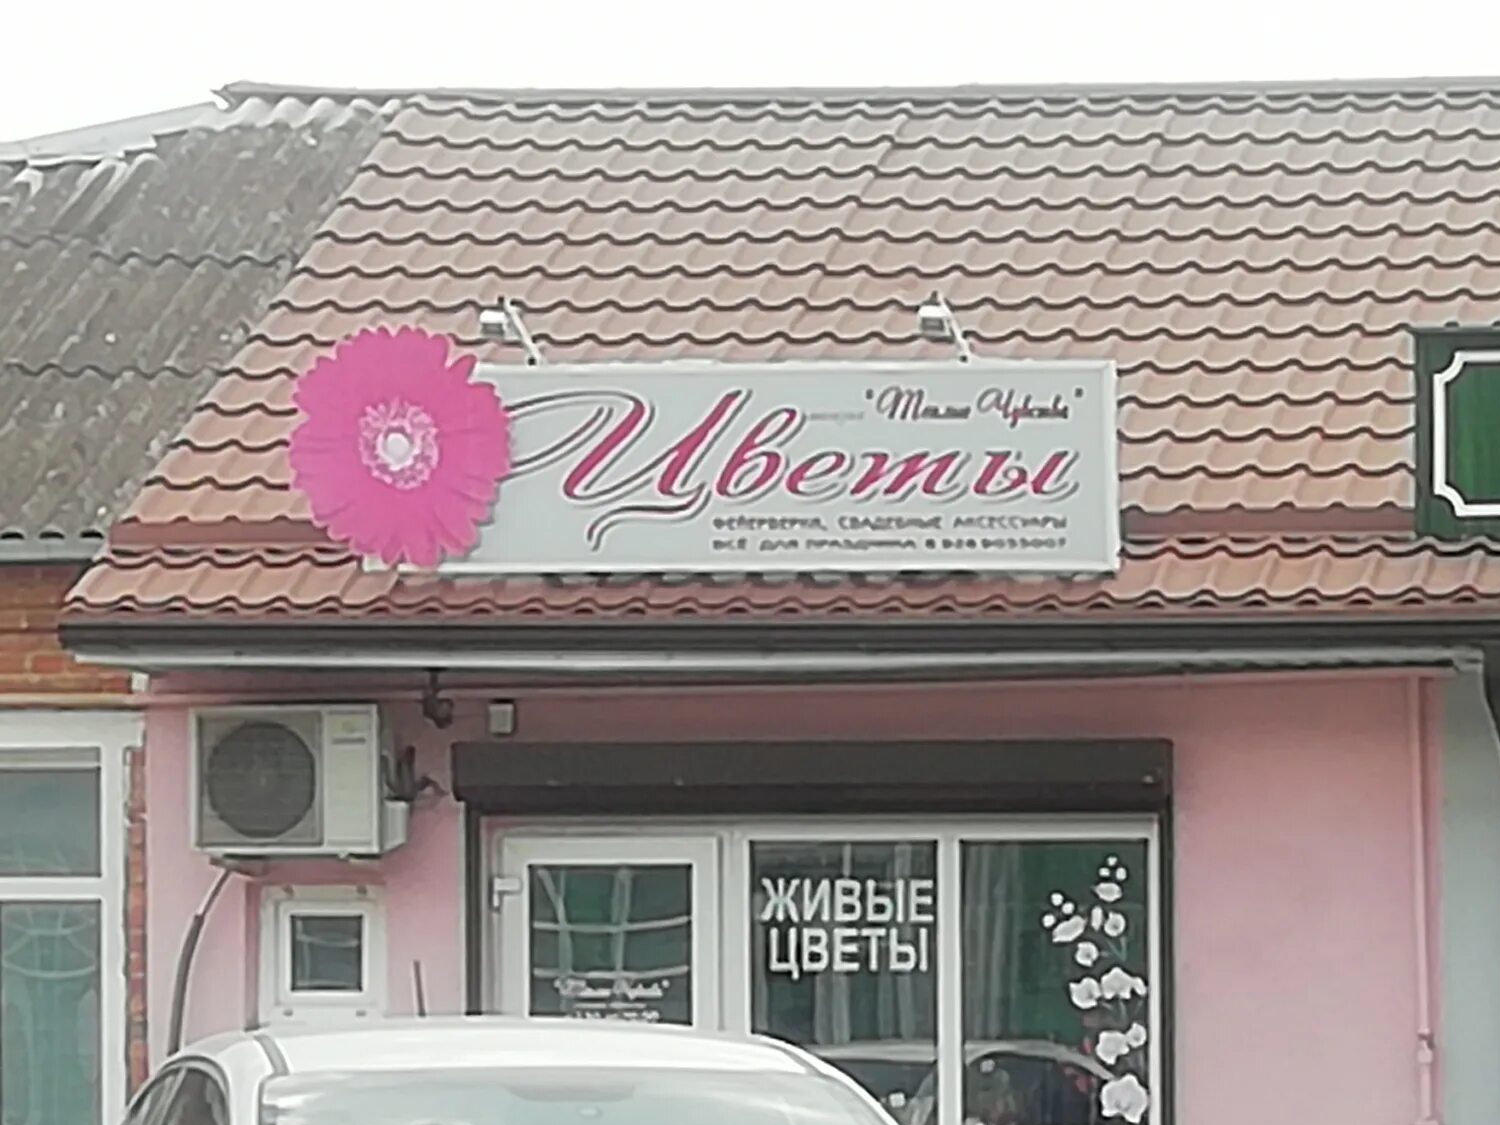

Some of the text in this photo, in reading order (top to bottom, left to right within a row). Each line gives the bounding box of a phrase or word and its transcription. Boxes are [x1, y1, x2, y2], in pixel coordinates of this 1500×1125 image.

[510, 387, 1080, 550] Цветы
[760, 877, 935, 923] ЖИВЫЕ
[768, 926, 928, 981] ЦВЕТЫ
